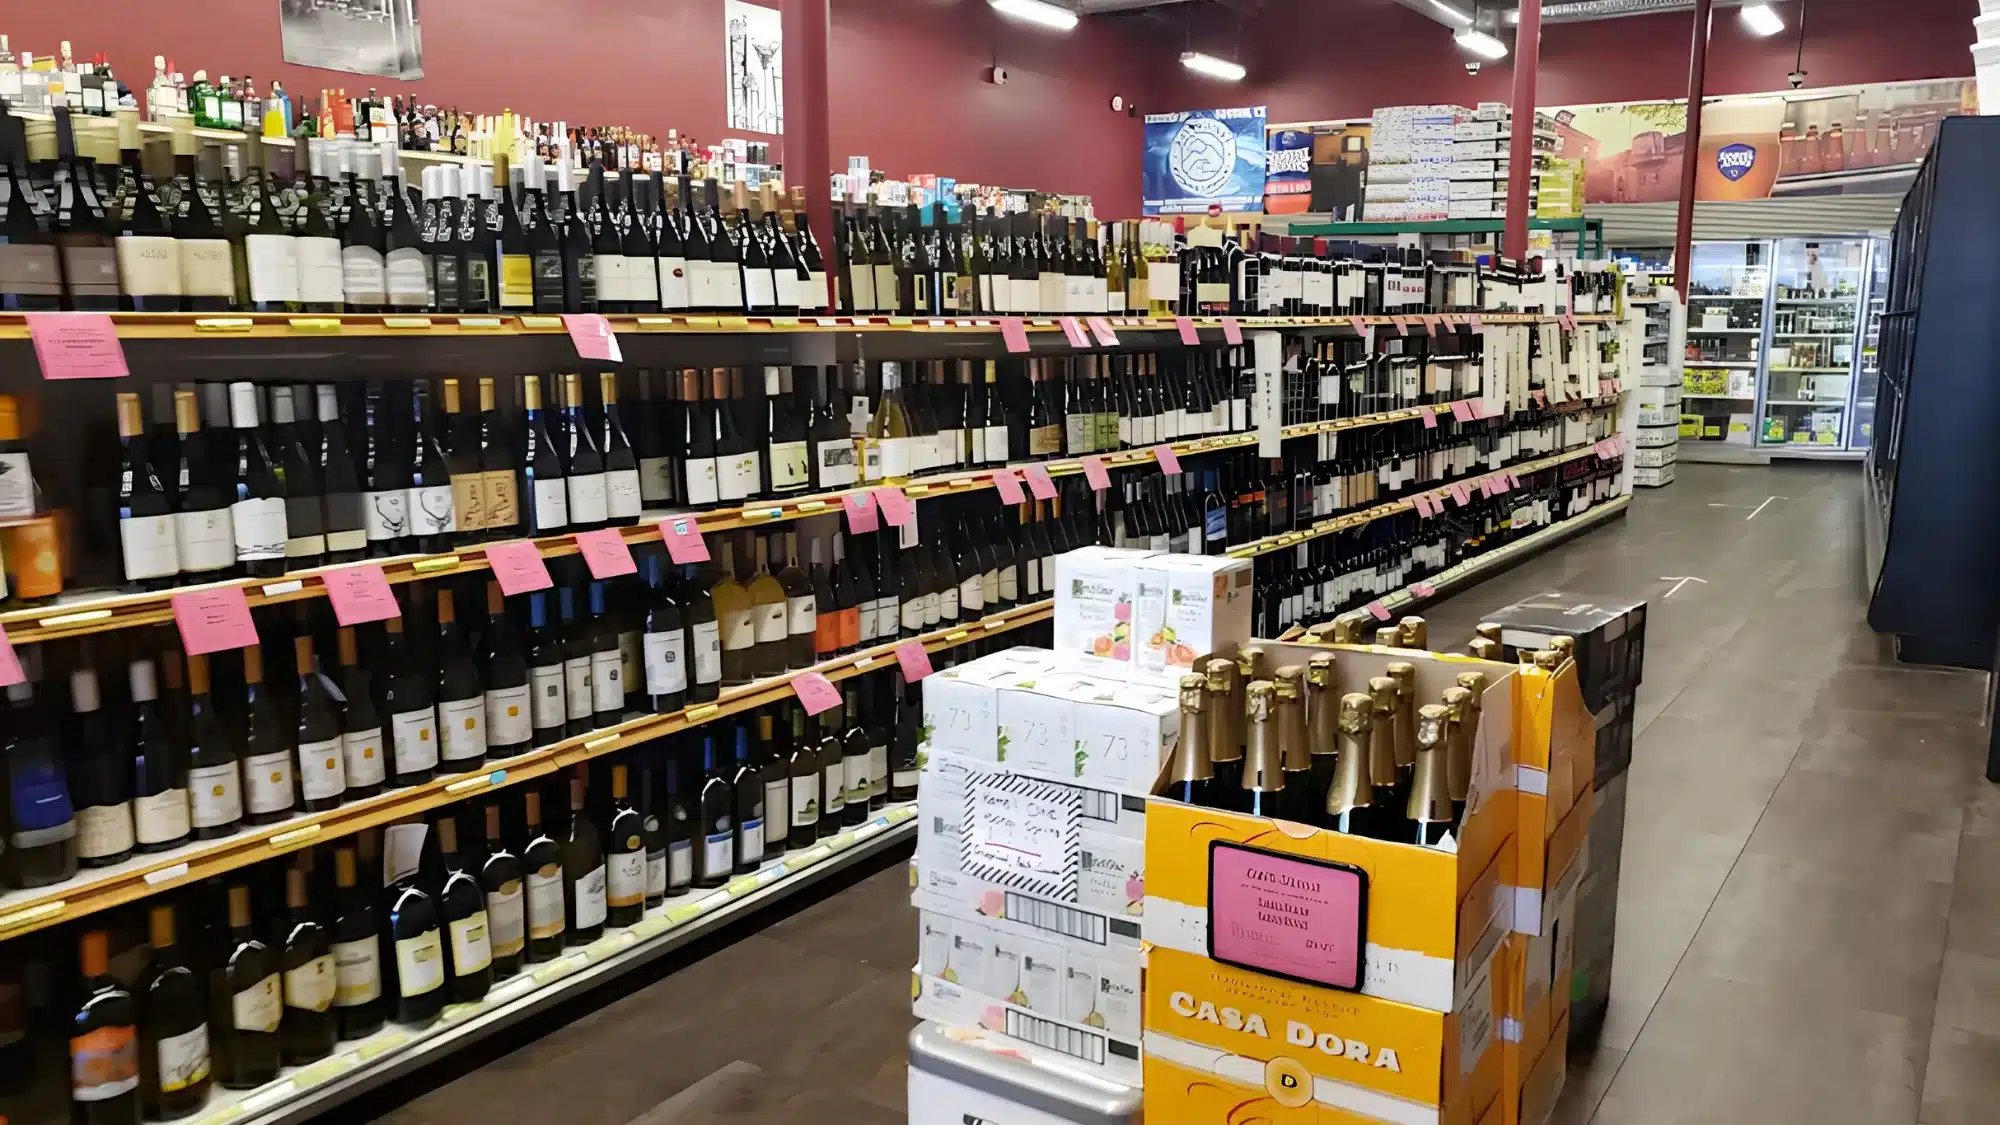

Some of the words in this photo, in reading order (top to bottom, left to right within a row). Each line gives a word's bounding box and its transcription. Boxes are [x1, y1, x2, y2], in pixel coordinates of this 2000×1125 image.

[1101, 733, 1129, 761] 73
[1170, 991, 1270, 1039] CASA
[1286, 1019, 1402, 1073] DORA
